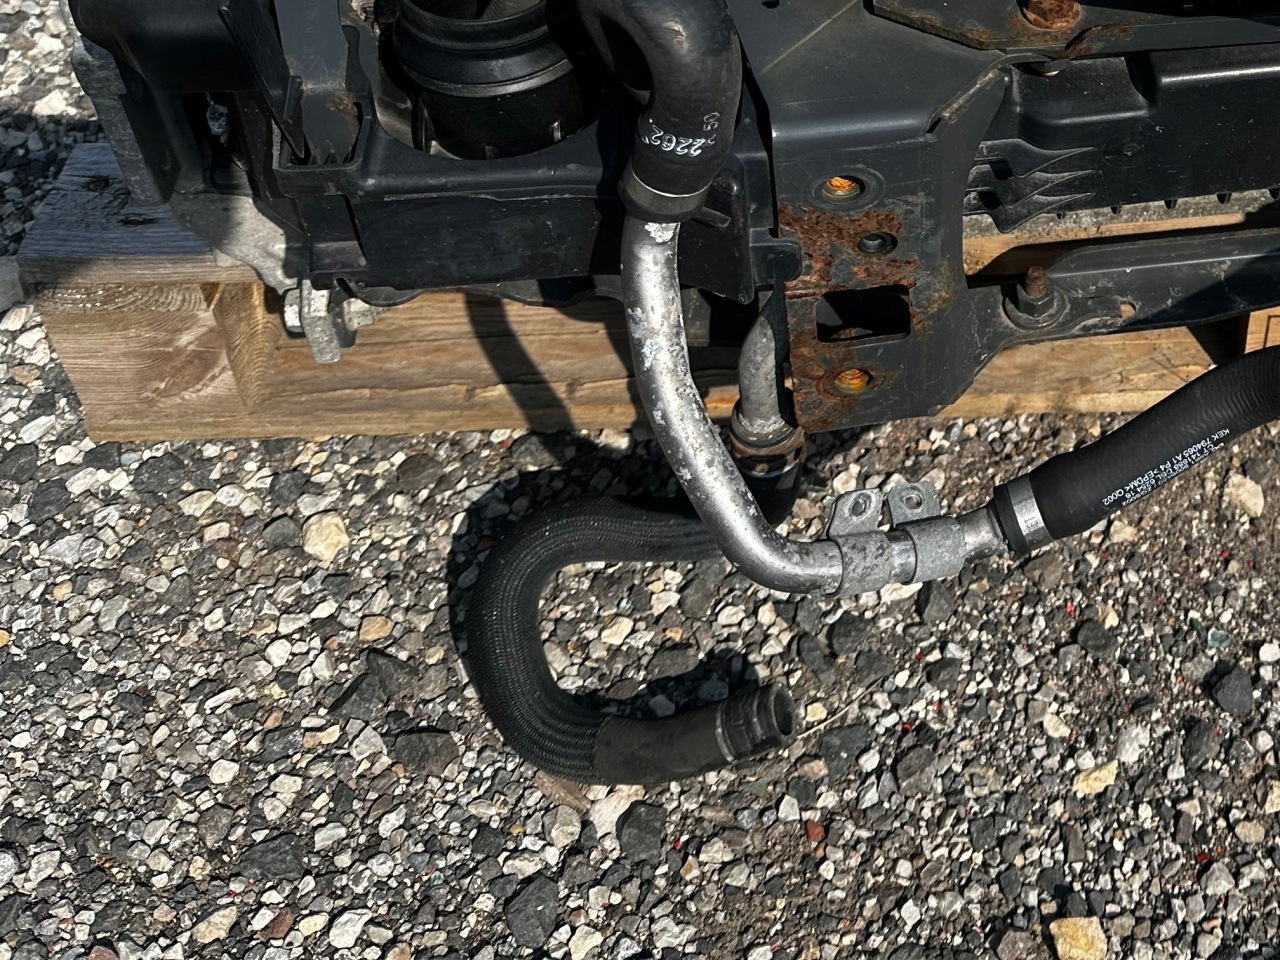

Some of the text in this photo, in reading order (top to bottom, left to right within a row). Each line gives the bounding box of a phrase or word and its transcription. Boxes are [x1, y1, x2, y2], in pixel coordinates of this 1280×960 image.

[1211, 428, 1230, 442] KEK
[1182, 437, 1211, 457] 794065
[1202, 443, 1214, 454] CT
[1172, 453, 1183, 464] A1
[1159, 461, 1171, 471] P4
[1102, 490, 1123, 506] Q002
